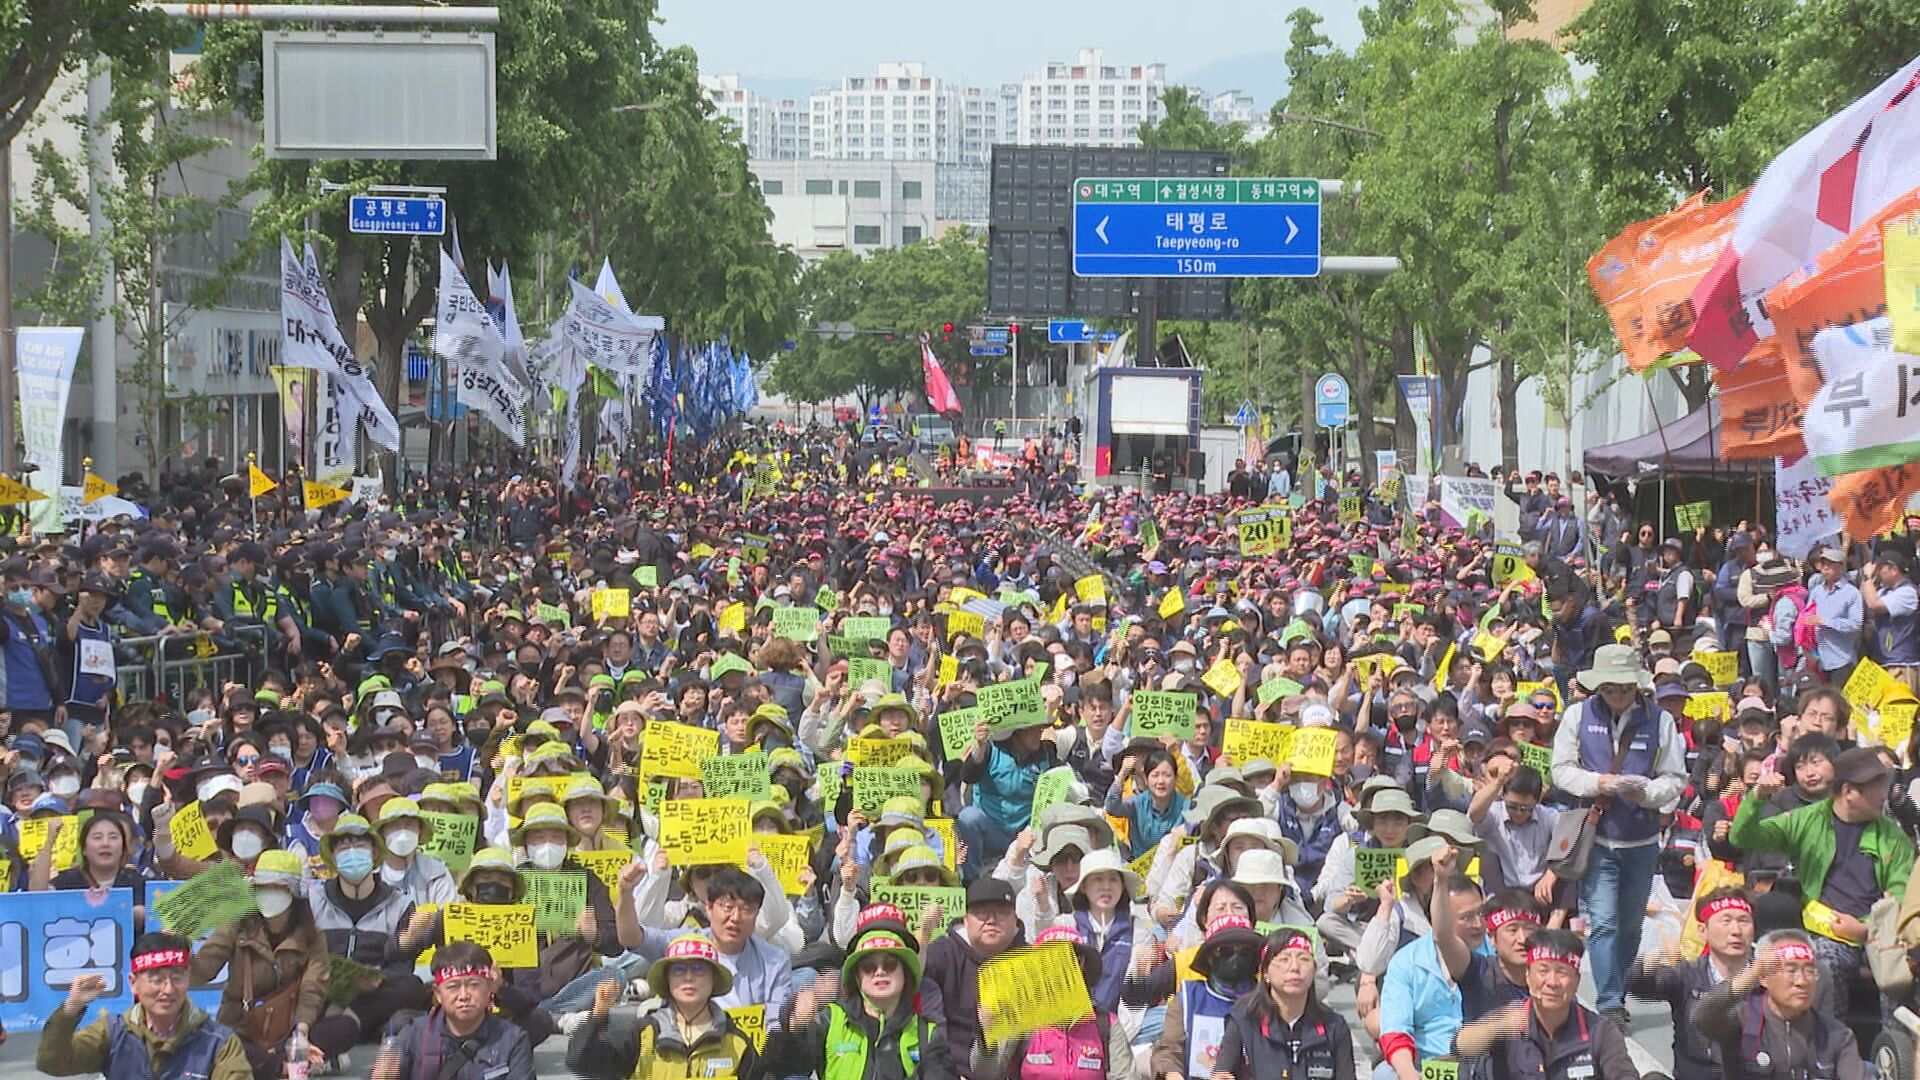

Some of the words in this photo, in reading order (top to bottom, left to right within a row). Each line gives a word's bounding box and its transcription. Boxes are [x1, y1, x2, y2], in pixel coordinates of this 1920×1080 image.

[1094, 183, 1141, 200] 대구역
[1176, 183, 1226, 200] 칠성시장
[1250, 183, 1301, 200] 동대구역
[365, 200, 408, 217] 공평로
[1165, 212, 1229, 234] 태평로
[1156, 235, 1240, 251] Taepyeong-ro
[1177, 258, 1217, 273] 150m
[1503, 557, 1516, 575] 9
[648, 722, 673, 741] 모든
[664, 802, 693, 821] 모든
[696, 801, 751, 824] 노동자의
[663, 825, 708, 853] 노동권
[710, 820, 747, 844] 쟁취!
[448, 905, 478, 926] 모든
[479, 909, 537, 931] 노동자의
[493, 928, 531, 949] 쟁취!
